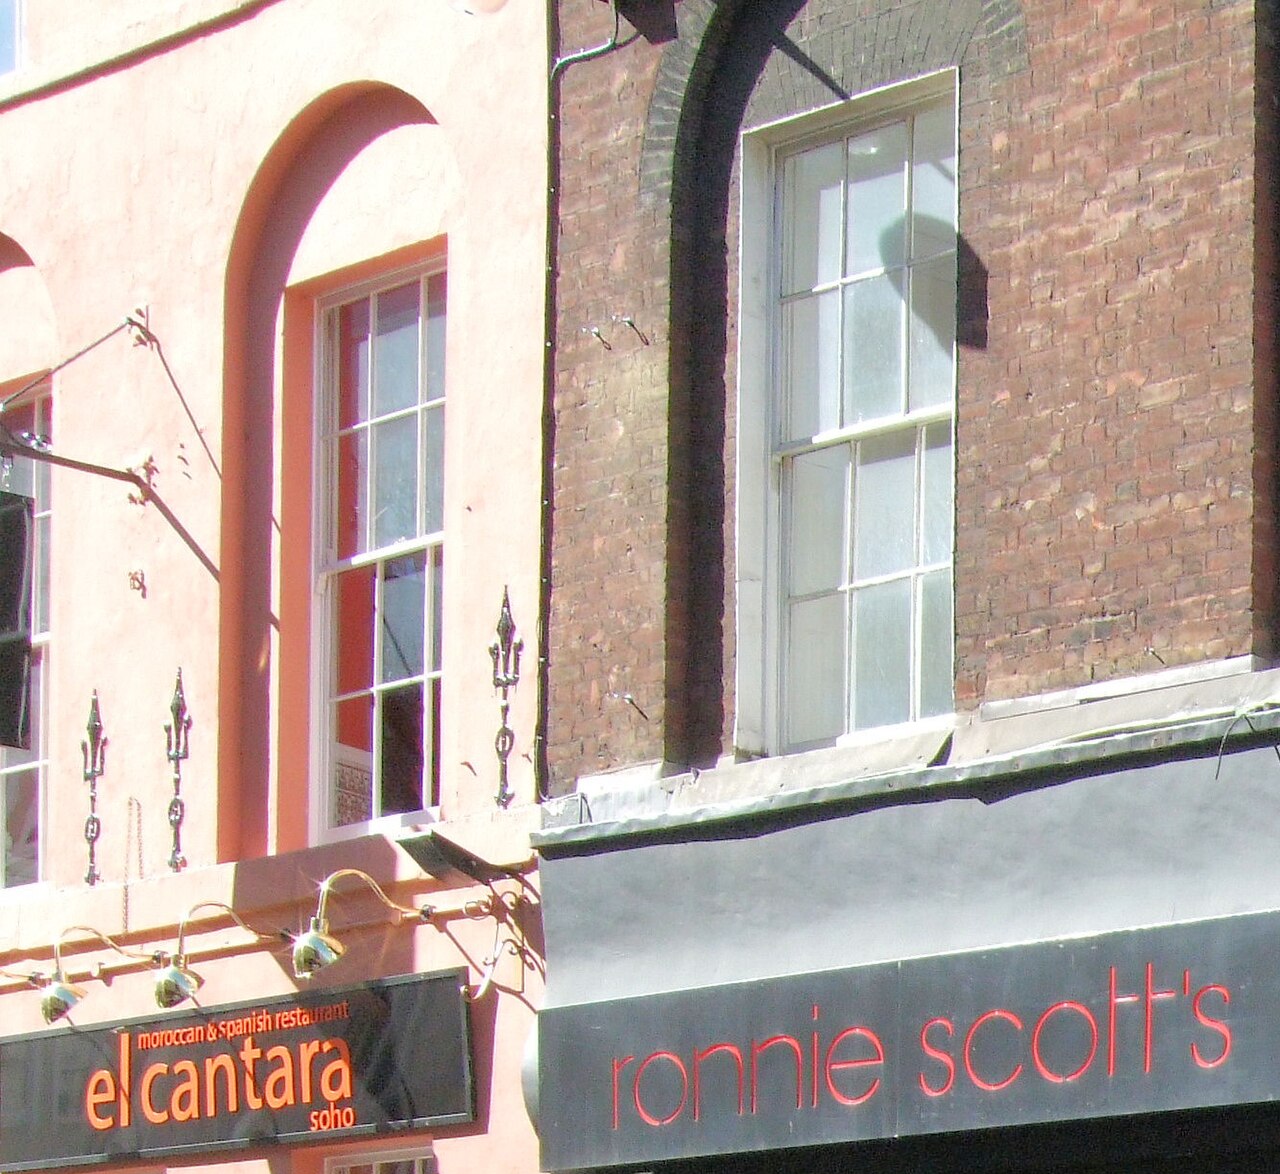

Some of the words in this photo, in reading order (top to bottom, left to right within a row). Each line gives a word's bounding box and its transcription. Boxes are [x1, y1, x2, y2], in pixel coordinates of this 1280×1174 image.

[137, 1026, 204, 1050] moroccan
[206, 1023, 219, 1042] &
[218, 1008, 272, 1041] spanish
[275, 1001, 350, 1031] restaurant
[611, 1003, 885, 1131] ronnie
[918, 962, 1233, 1098] scott's
[86, 1031, 131, 1132] el
[140, 1035, 353, 1125] cantara
[310, 1102, 355, 1132] soho
